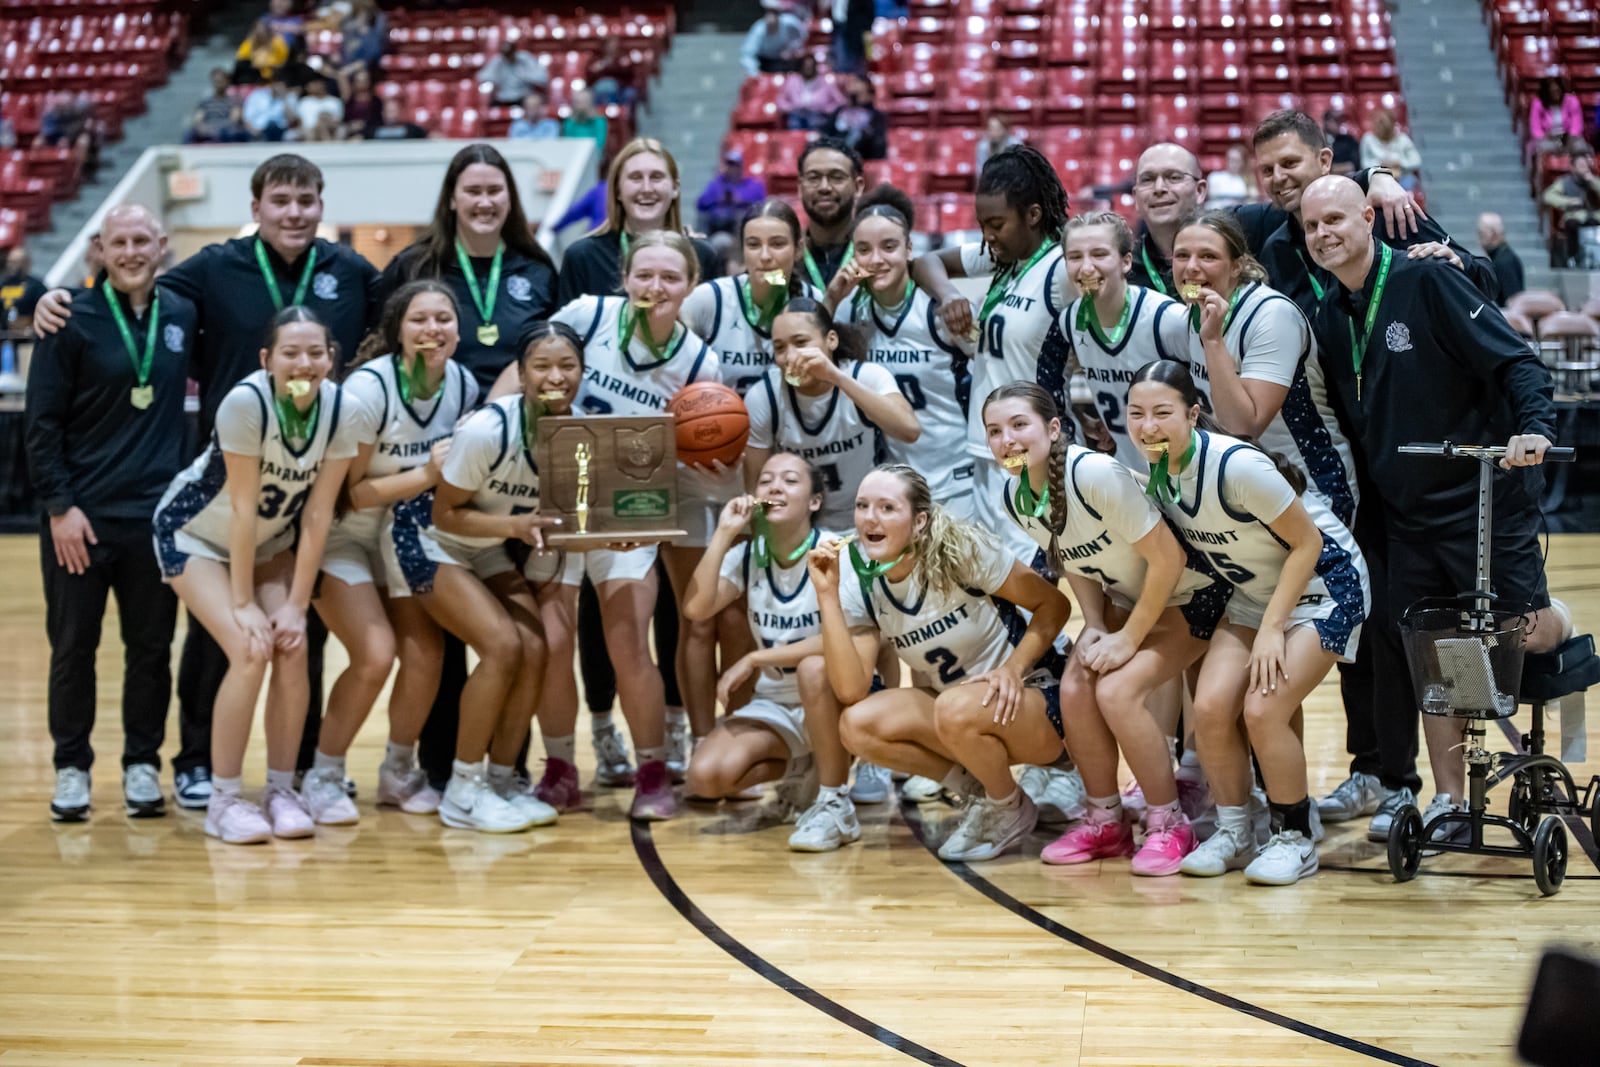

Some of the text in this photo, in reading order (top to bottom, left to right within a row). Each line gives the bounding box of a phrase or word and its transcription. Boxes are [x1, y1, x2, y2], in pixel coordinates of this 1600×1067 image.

[722, 351, 775, 366] FAIRM
[866, 349, 932, 363] IRMONT
[1080, 366, 1137, 383] AIRMO
[1096, 391, 1128, 434] 2
[777, 432, 863, 459] RMONT
[489, 479, 540, 498] FAIRM
[1060, 529, 1112, 562] RMONT
[1182, 527, 1239, 545] IRMONT
[749, 609, 822, 630] AIRMONT
[925, 646, 966, 684] 2
